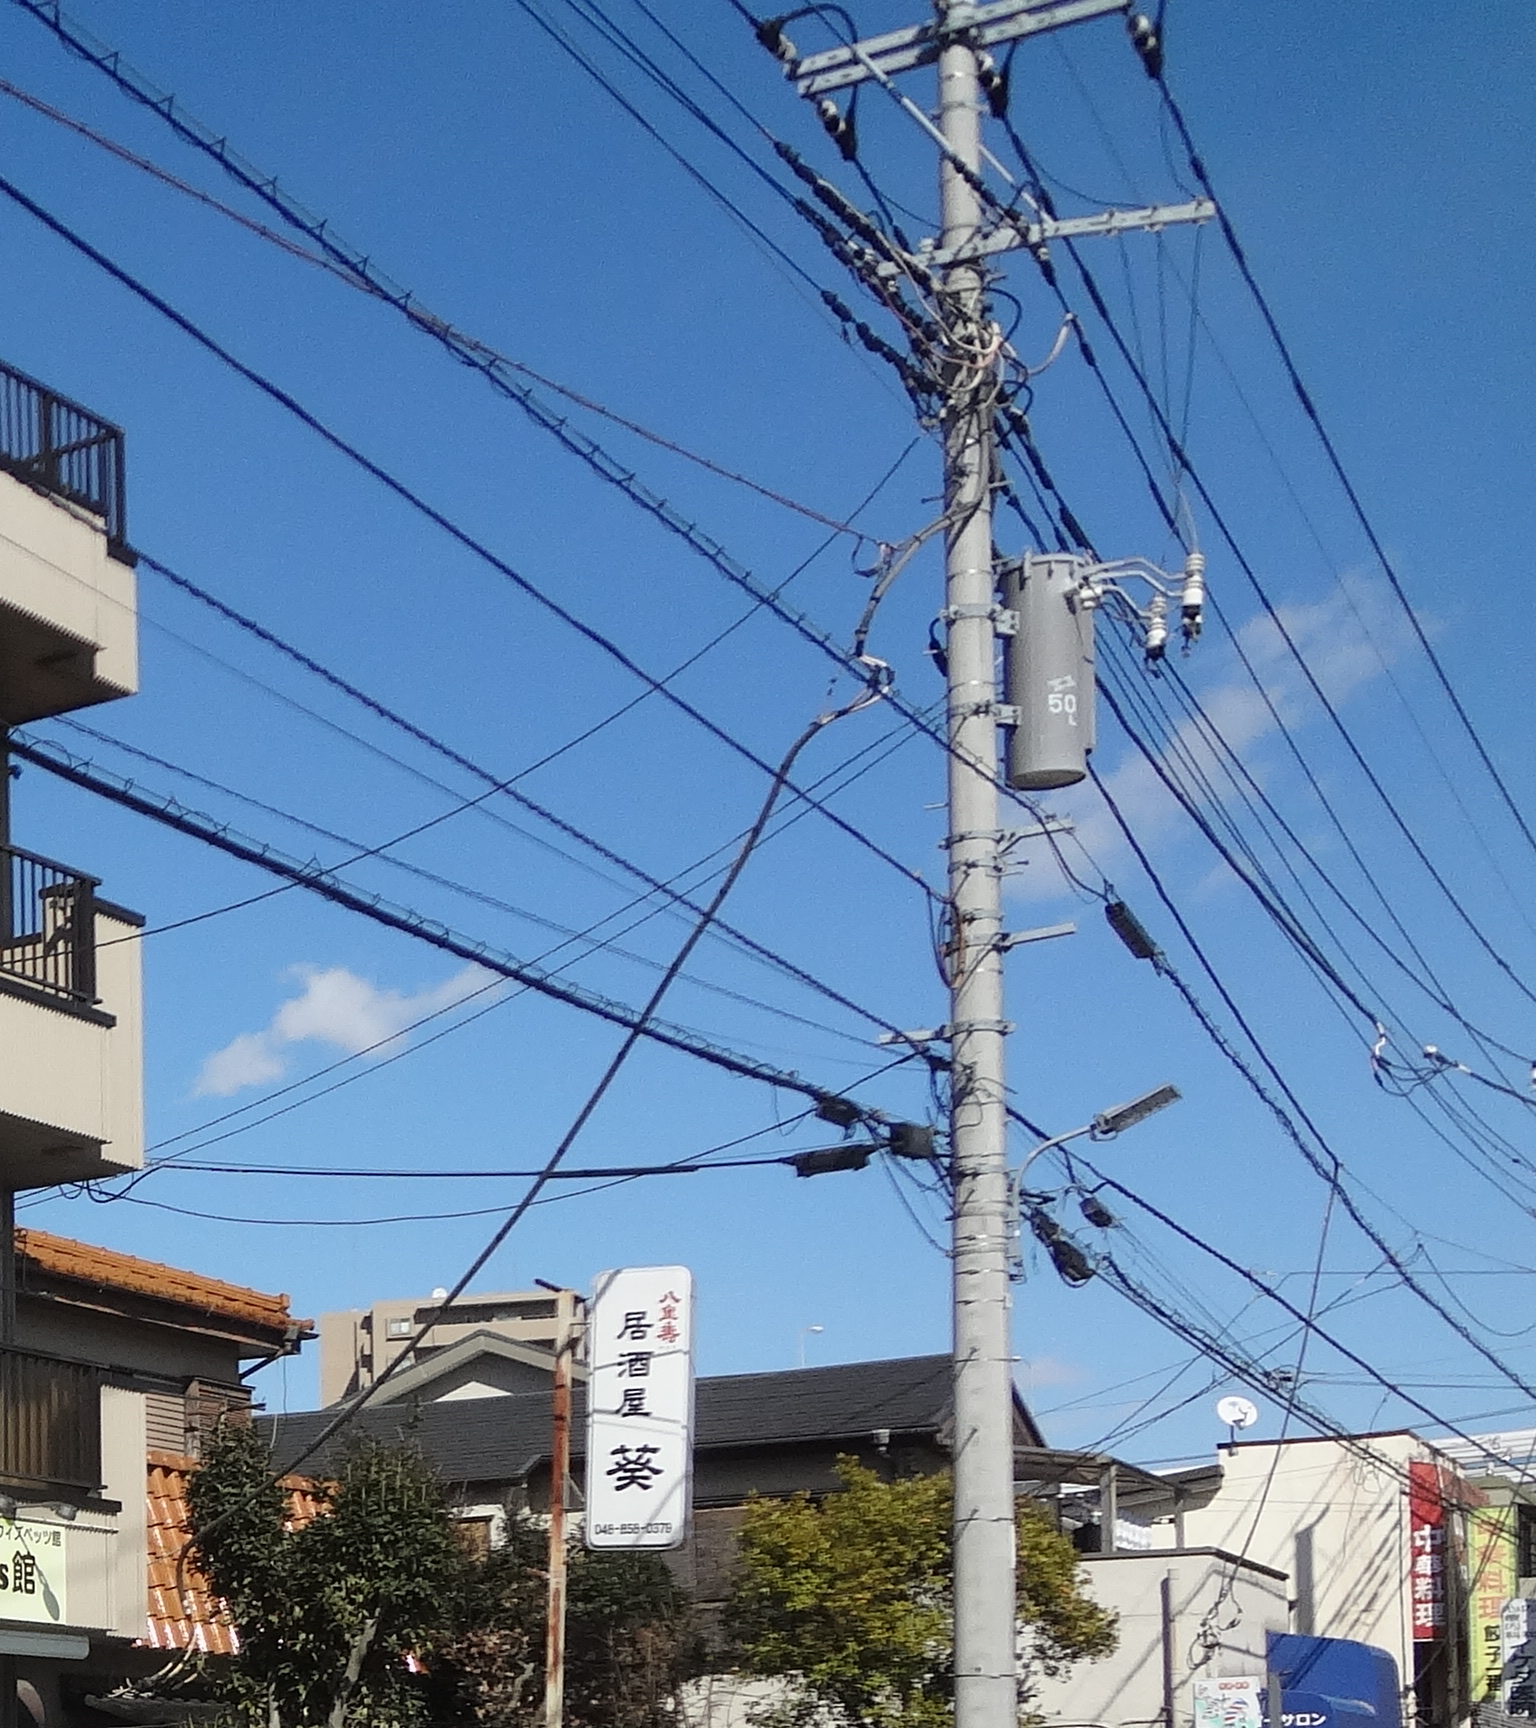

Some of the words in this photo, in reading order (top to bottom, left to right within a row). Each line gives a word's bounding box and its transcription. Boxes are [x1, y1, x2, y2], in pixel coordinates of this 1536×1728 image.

[1048, 694, 1076, 713] 50
[615, 1311, 655, 1418] 居酒屋
[606, 1444, 664, 1491] 葵
[1413, 1524, 1446, 1627] 中華料理
